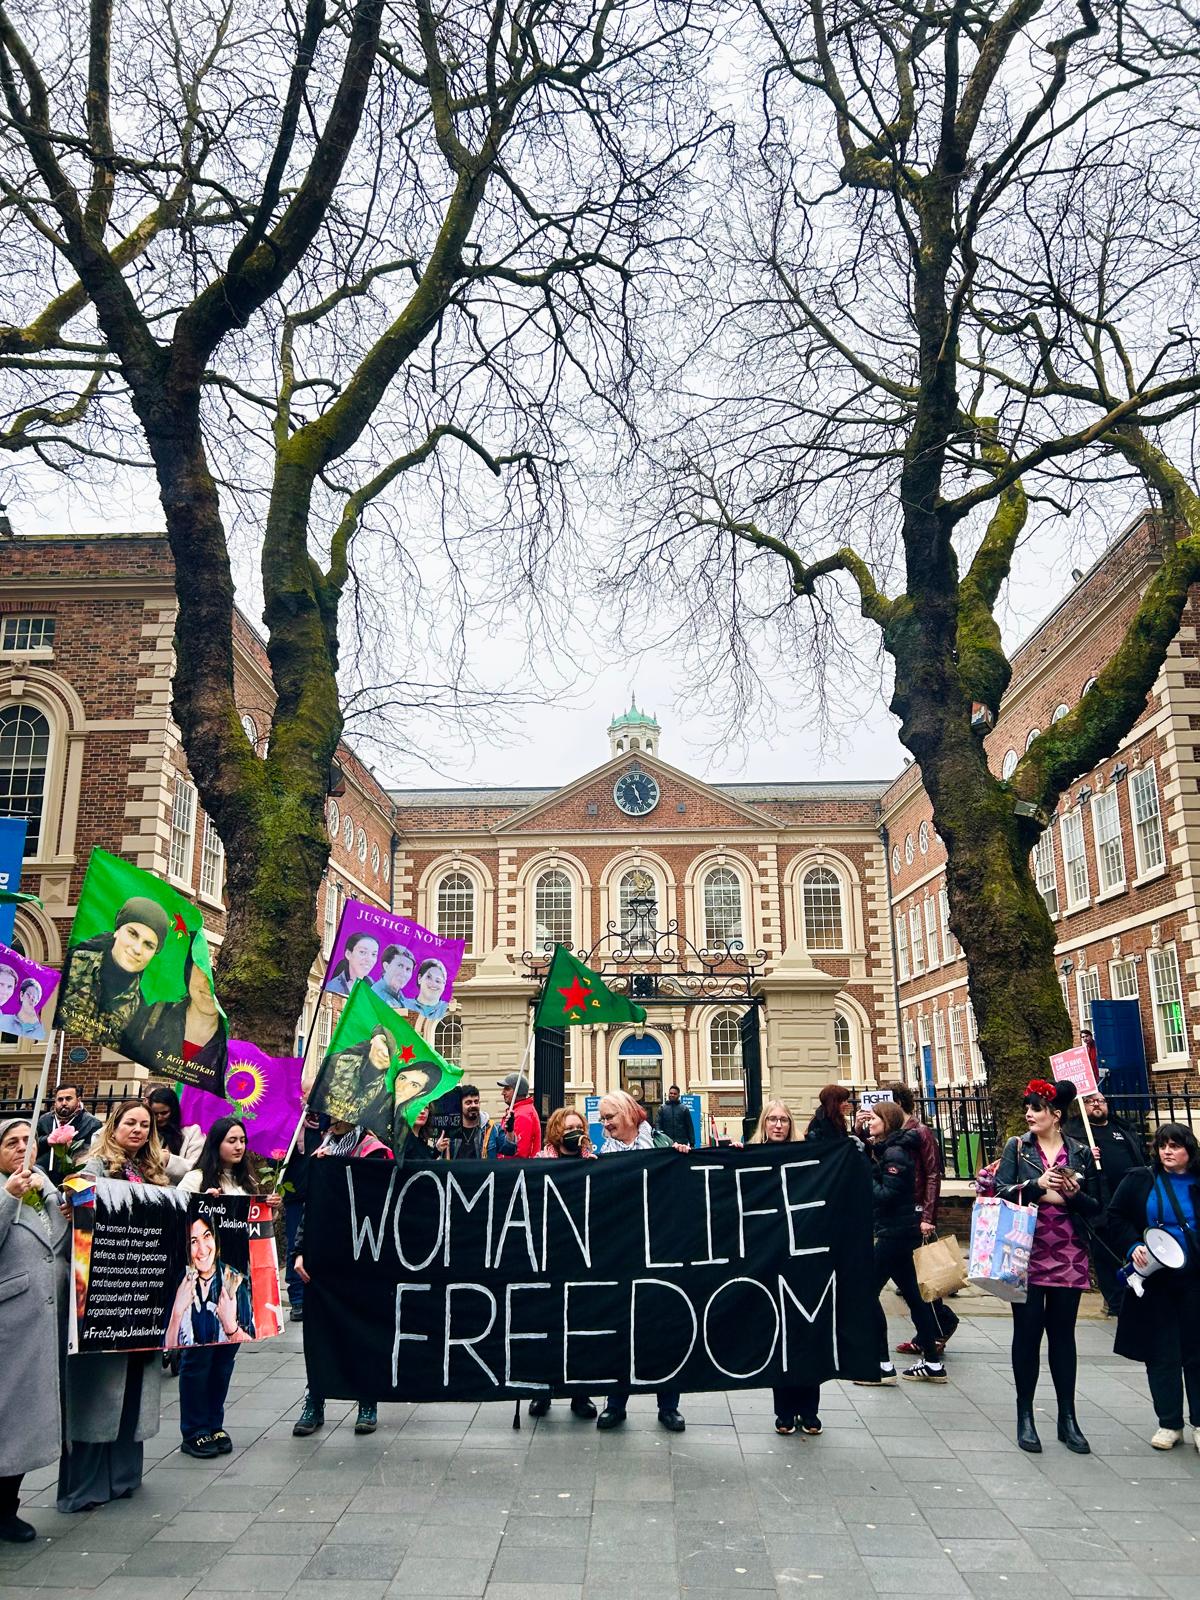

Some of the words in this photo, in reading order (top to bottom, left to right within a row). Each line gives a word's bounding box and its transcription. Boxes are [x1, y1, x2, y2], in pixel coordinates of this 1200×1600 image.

[357, 910, 410, 935] JUSTICE
[414, 930, 445, 947] NOW
[186, 1061, 215, 1076] Mirkan
[864, 1095, 890, 1104] FIGHT
[198, 1201, 226, 1217] Zeynab
[345, 1165, 591, 1272] WOMAN
[643, 1160, 830, 1268] LIFE
[219, 1216, 248, 1229] Jalalian
[96, 1222, 106, 1232] The
[128, 1226, 143, 1234] have
[143, 1228, 162, 1236] great
[116, 1238, 130, 1247] with
[145, 1239, 160, 1248] self-
[126, 1252, 141, 1262] they
[142, 1253, 167, 1262] become
[140, 1267, 166, 1276] stronger
[92, 1279, 104, 1287] and
[132, 1280, 147, 1288] even
[149, 1280, 164, 1288] more
[118, 1293, 132, 1302] with
[134, 1292, 149, 1302] their
[134, 1308, 152, 1316] every
[392, 1270, 839, 1389] FREEDOM
